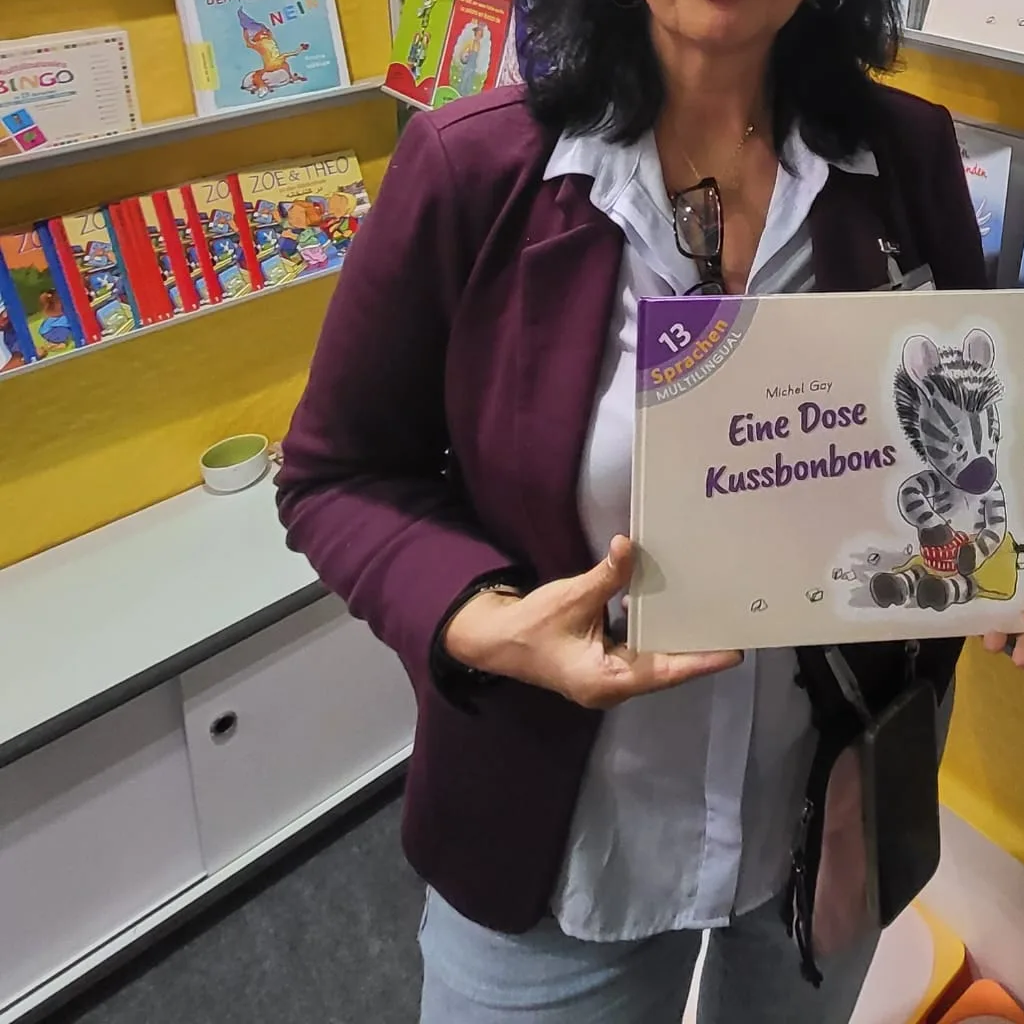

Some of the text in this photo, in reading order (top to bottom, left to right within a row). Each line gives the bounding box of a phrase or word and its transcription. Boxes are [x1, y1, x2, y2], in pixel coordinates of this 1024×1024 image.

[248, 171, 286, 194] ZOE
[289, 170, 300, 181] &
[305, 156, 349, 180] THEO
[650, 319, 728, 385] Sprachen
[658, 322, 693, 353] 13
[655, 330, 743, 401] MULTILINGUAL
[766, 381, 805, 399] Michel
[728, 401, 868, 447] Eine Dose
[705, 443, 897, 498] Kussbonbons
